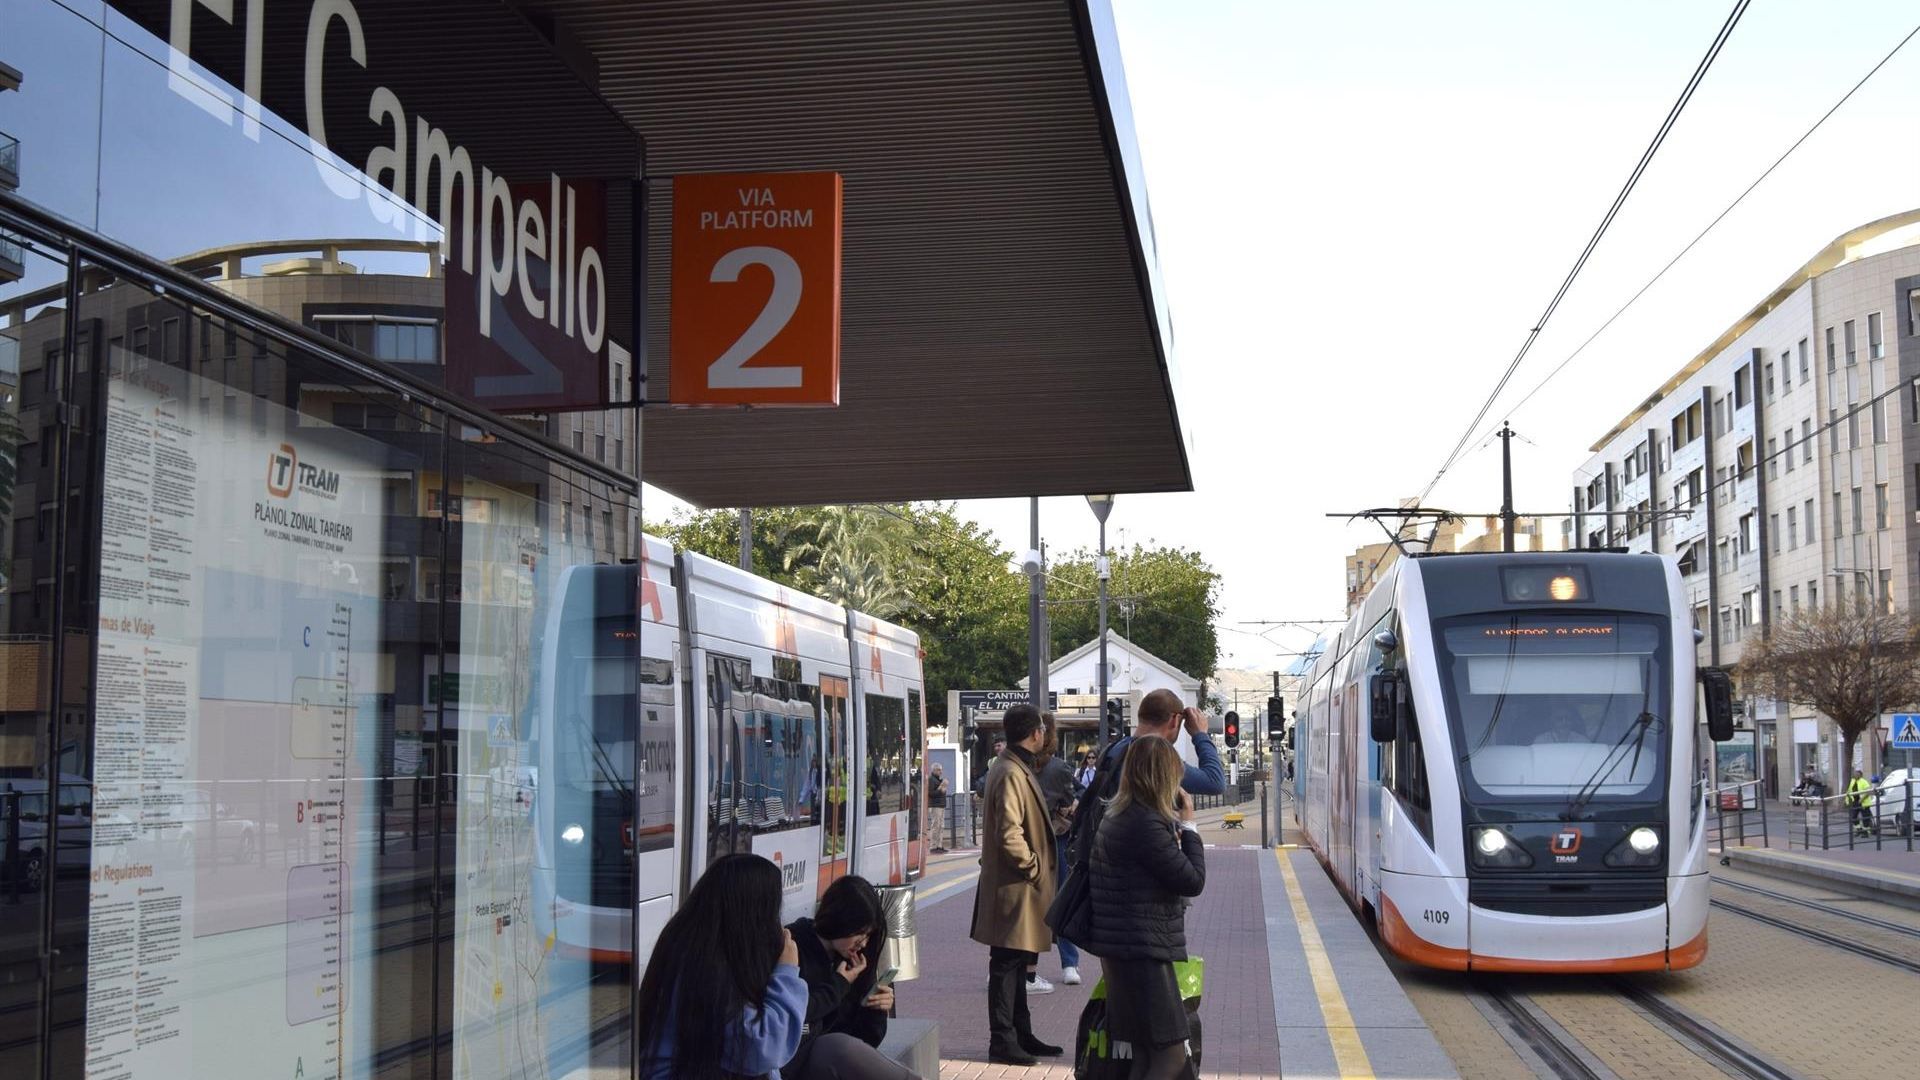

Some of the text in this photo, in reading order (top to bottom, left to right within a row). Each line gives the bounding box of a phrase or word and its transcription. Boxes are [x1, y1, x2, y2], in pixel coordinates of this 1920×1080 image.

[304, 0, 605, 354] Campello
[738, 188, 775, 206] VIA
[700, 209, 813, 230] PLATFORM
[707, 246, 803, 389] 2
[298, 462, 339, 494] TRAM
[290, 512, 318, 534] ZONAL
[319, 519, 353, 541] TARIFARI
[121, 615, 132, 633] de
[133, 617, 155, 639] Viaje
[303, 626, 311, 648] C
[979, 701, 993, 710] EL
[297, 801, 304, 823] B
[1555, 855, 1578, 863] TRAM
[104, 863, 153, 885] Regulations
[782, 859, 806, 888] TRAM
[1423, 909, 1449, 925] 4109
[295, 1056, 304, 1080] A
